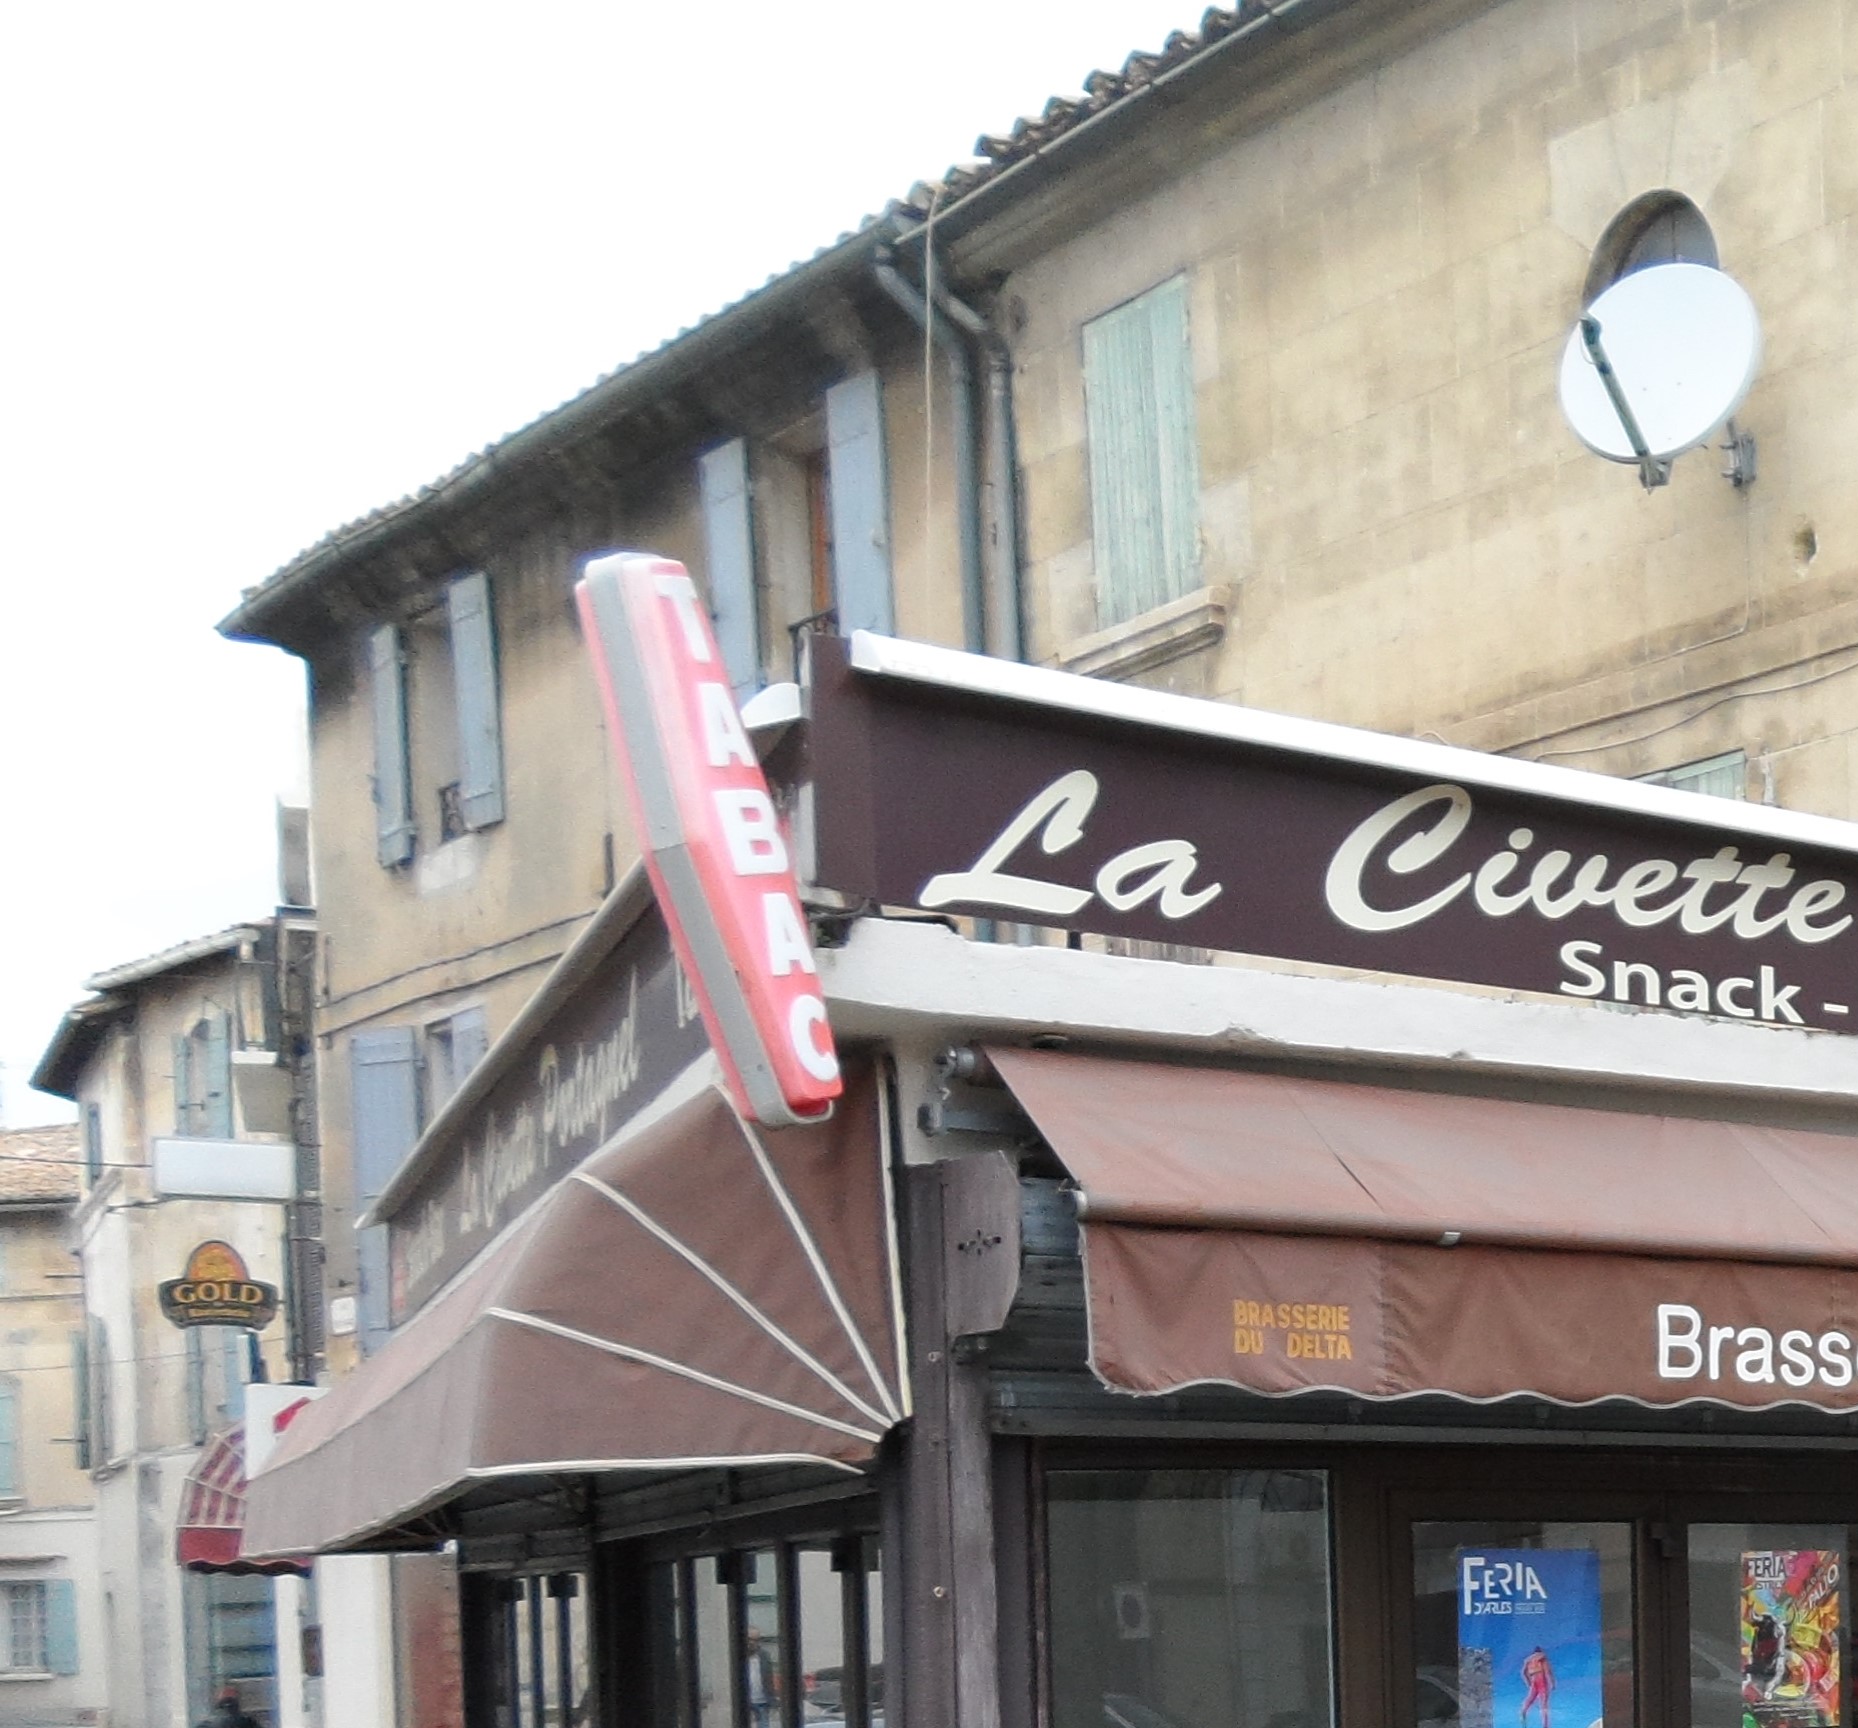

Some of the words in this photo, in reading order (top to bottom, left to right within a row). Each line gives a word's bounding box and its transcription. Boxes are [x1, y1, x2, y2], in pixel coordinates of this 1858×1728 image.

[656, 575, 838, 1081] TABAC
[919, 769, 1222, 918] La
[1325, 784, 1854, 943] Civette
[1559, 940, 1805, 1024] Snack
[173, 1283, 263, 1304] GOLD
[1233, 1299, 1350, 1331] BRASSERIE
[1234, 1328, 1264, 1354] DU
[1286, 1332, 1352, 1360] DELTA
[1463, 1557, 1548, 1615] FERIA
